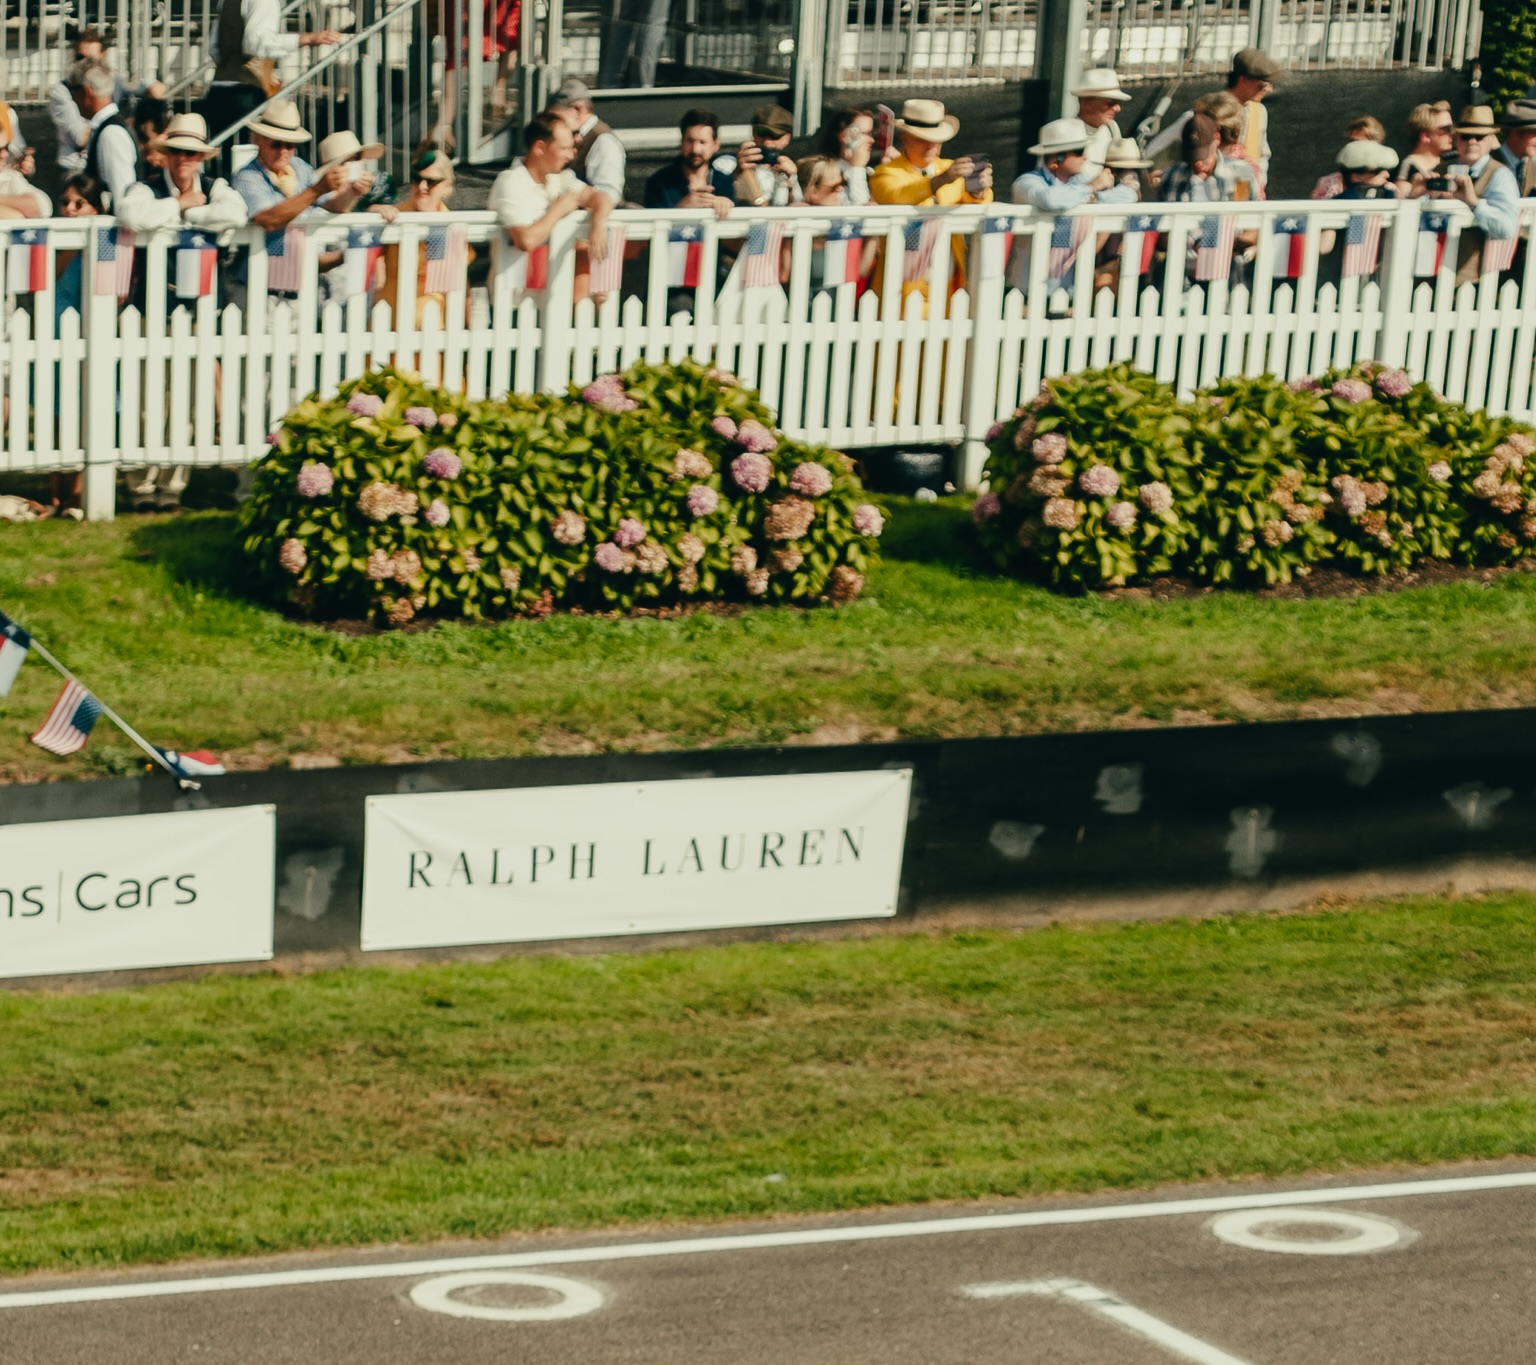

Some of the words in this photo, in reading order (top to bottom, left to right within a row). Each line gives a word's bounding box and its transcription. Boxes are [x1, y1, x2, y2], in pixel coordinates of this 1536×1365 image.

[408, 842, 597, 888] RALPH
[641, 825, 866, 876] LAUREN
[75, 871, 198, 911] Cars
